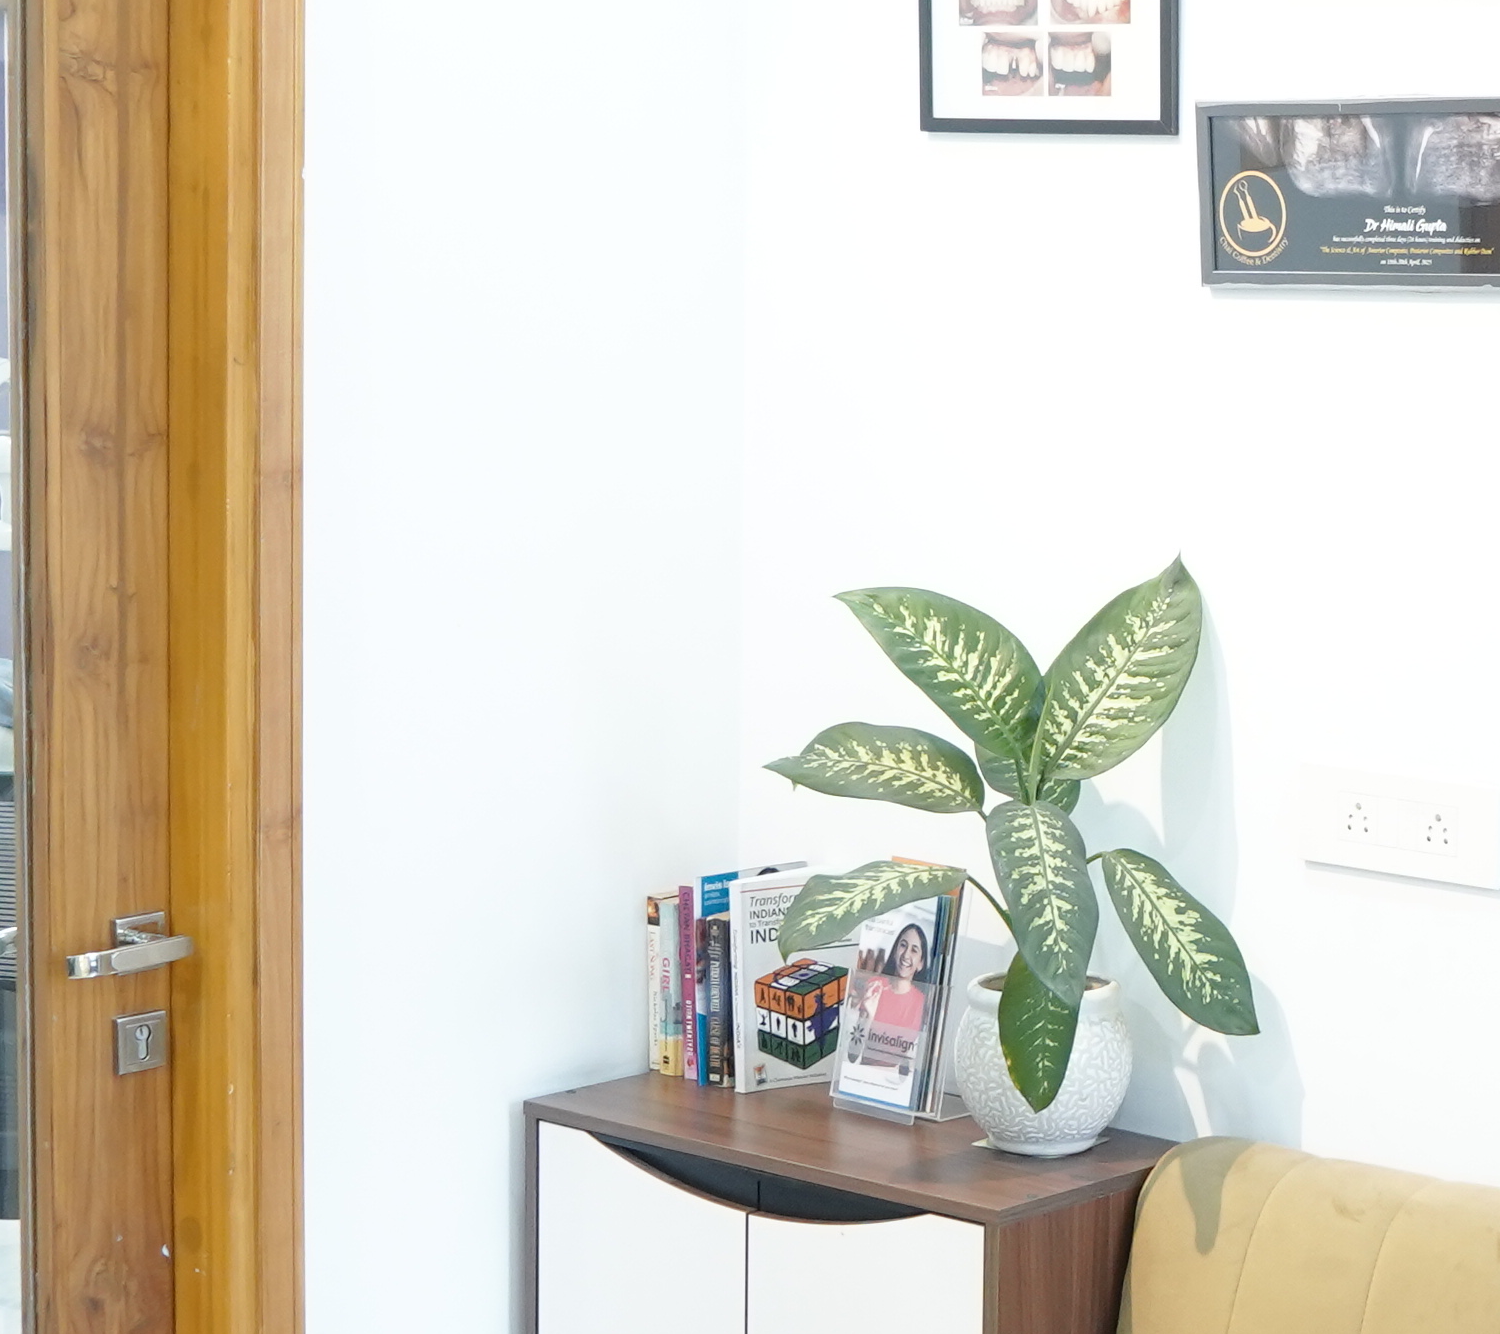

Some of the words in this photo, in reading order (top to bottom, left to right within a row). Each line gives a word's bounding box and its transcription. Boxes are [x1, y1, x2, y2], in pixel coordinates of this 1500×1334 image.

[1383, 205, 1395, 213] This
[1408, 206, 1426, 215] Certify
[1363, 218, 1380, 233] Dr
[1380, 219, 1414, 233] Himali
[1416, 219, 1447, 236] Gupta
[1232, 252, 1254, 266] Coffee
[1262, 237, 1289, 265] Dentistry
[682, 891, 690, 930] CHETAN
[684, 934, 692, 971] BHAGAT
[662, 957, 670, 993] GIRL
[868, 1029, 914, 1053] invisalign
